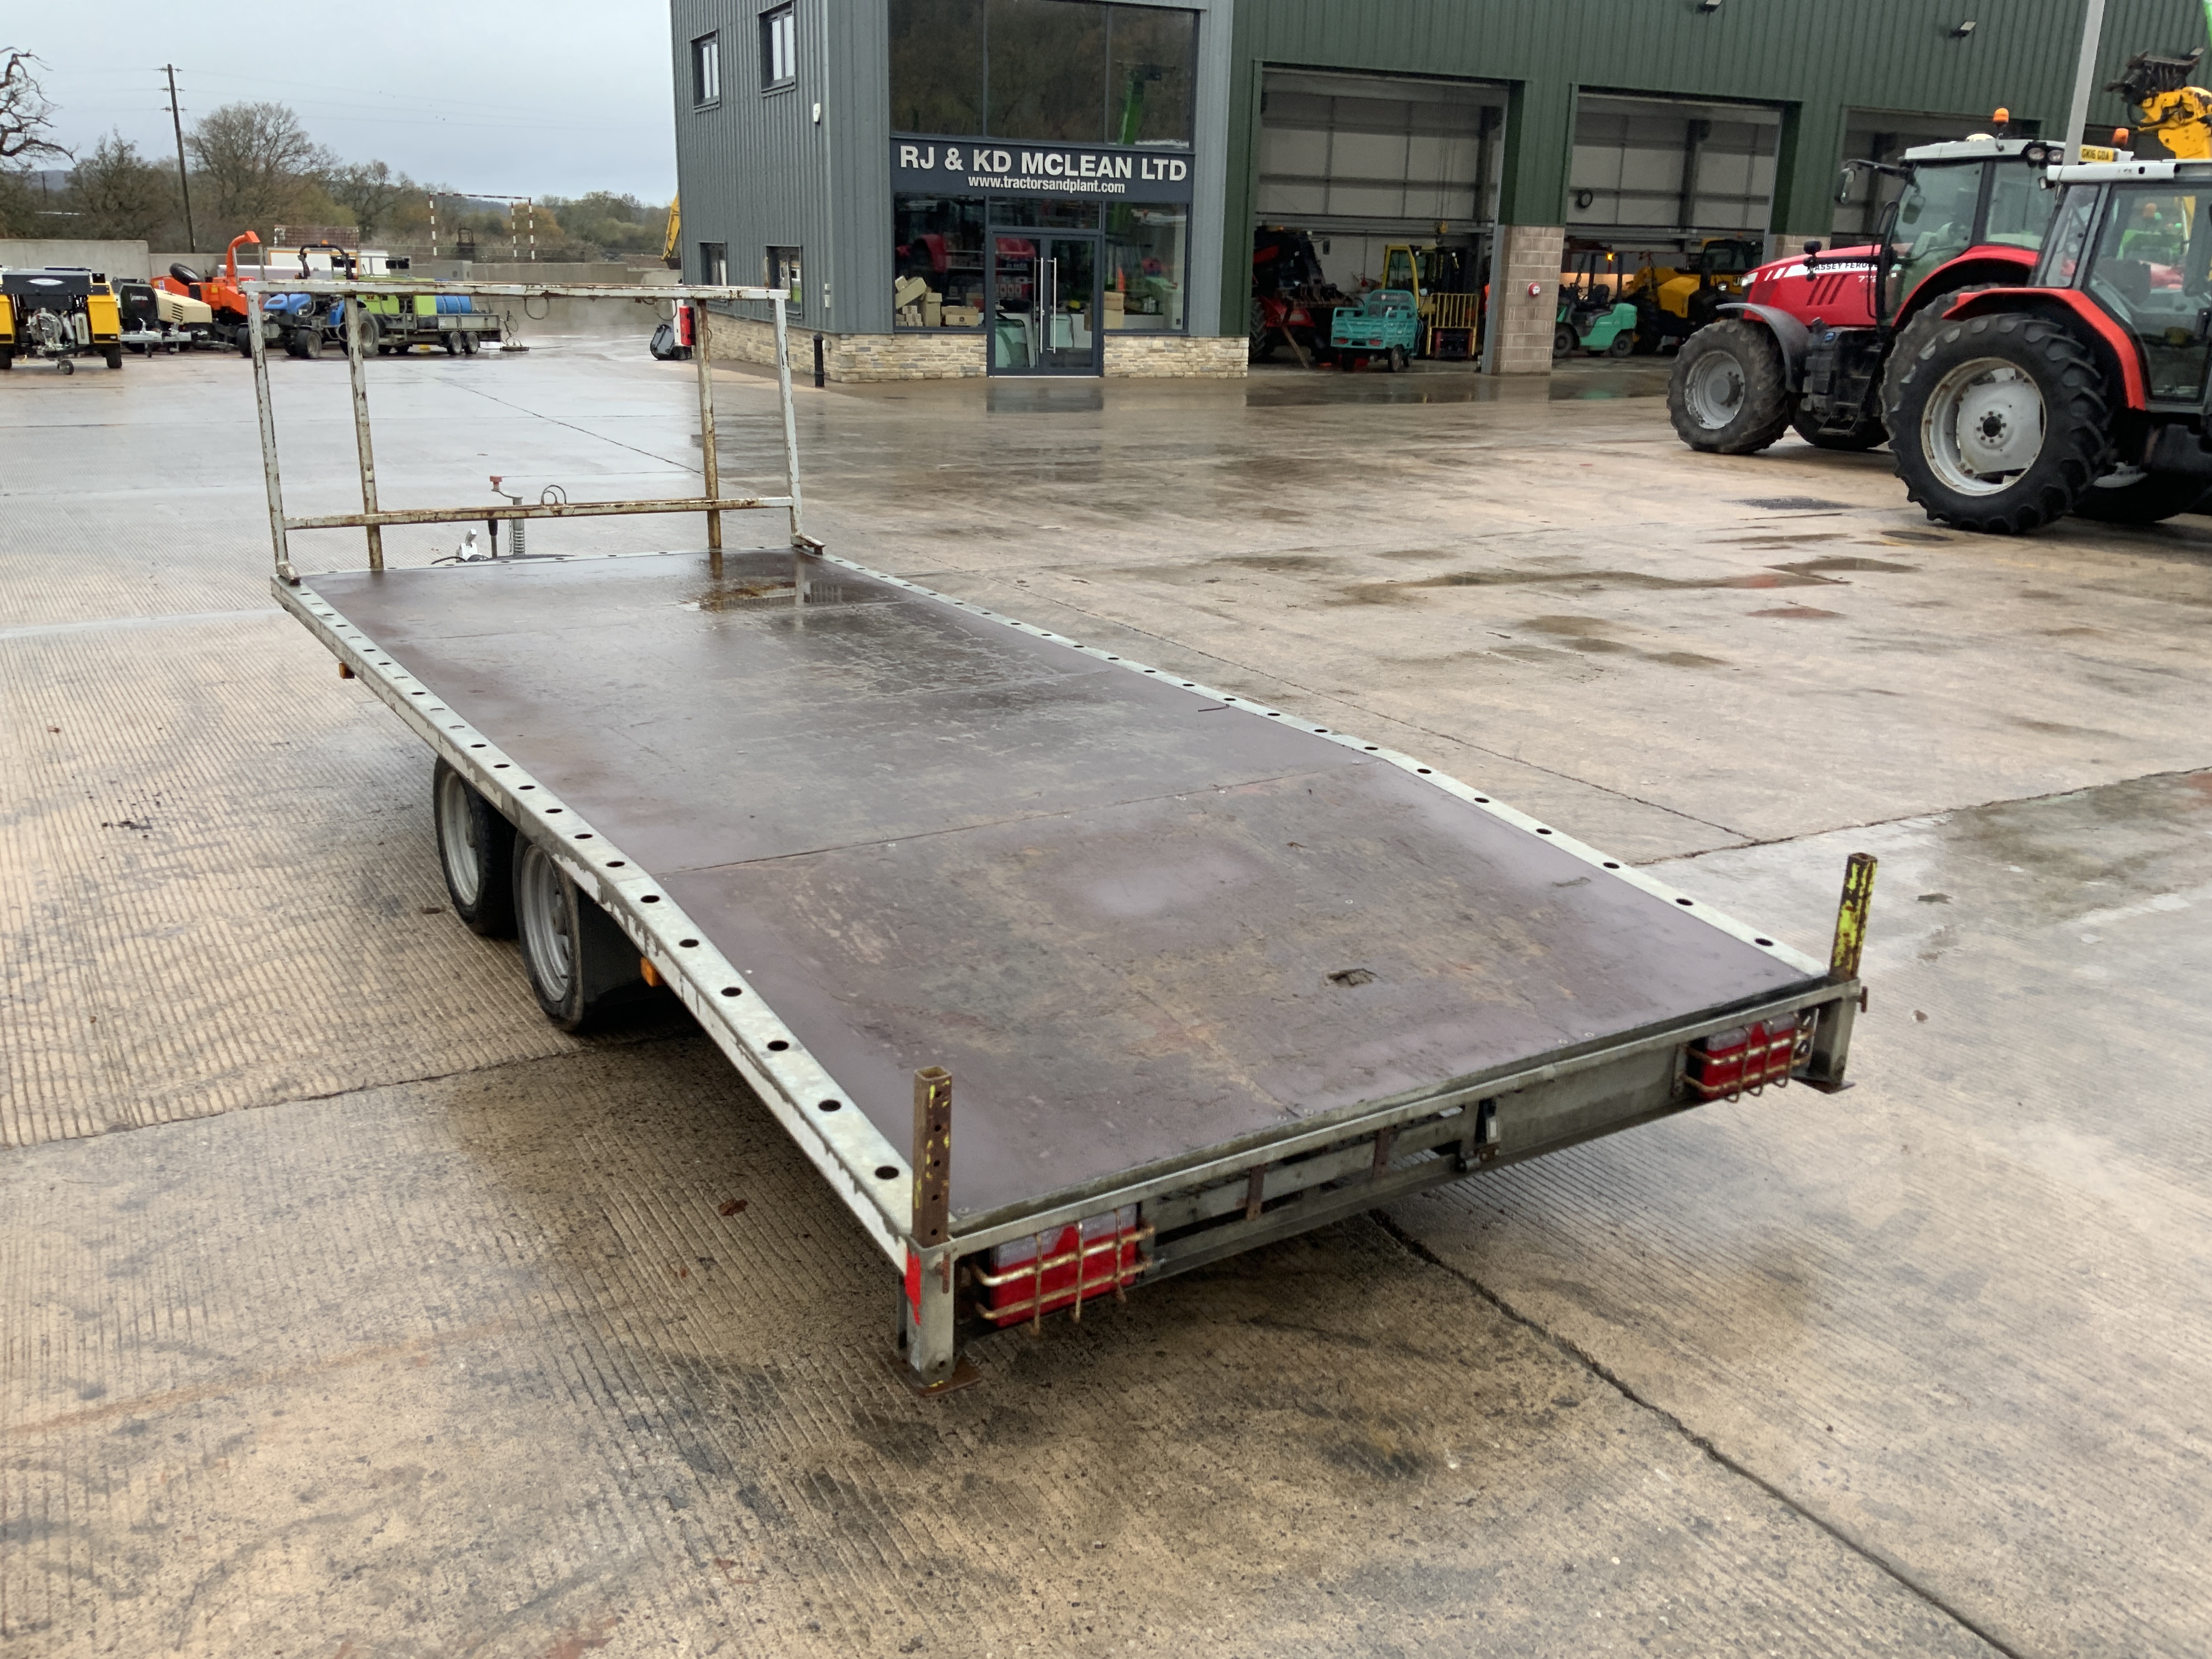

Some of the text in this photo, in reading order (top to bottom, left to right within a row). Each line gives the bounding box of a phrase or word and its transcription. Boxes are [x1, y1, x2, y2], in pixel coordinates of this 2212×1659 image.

[900, 145, 1187, 181] RJ & KD MCLEAN LTD
[968, 175, 1125, 193] www.tractorsandplant.com
